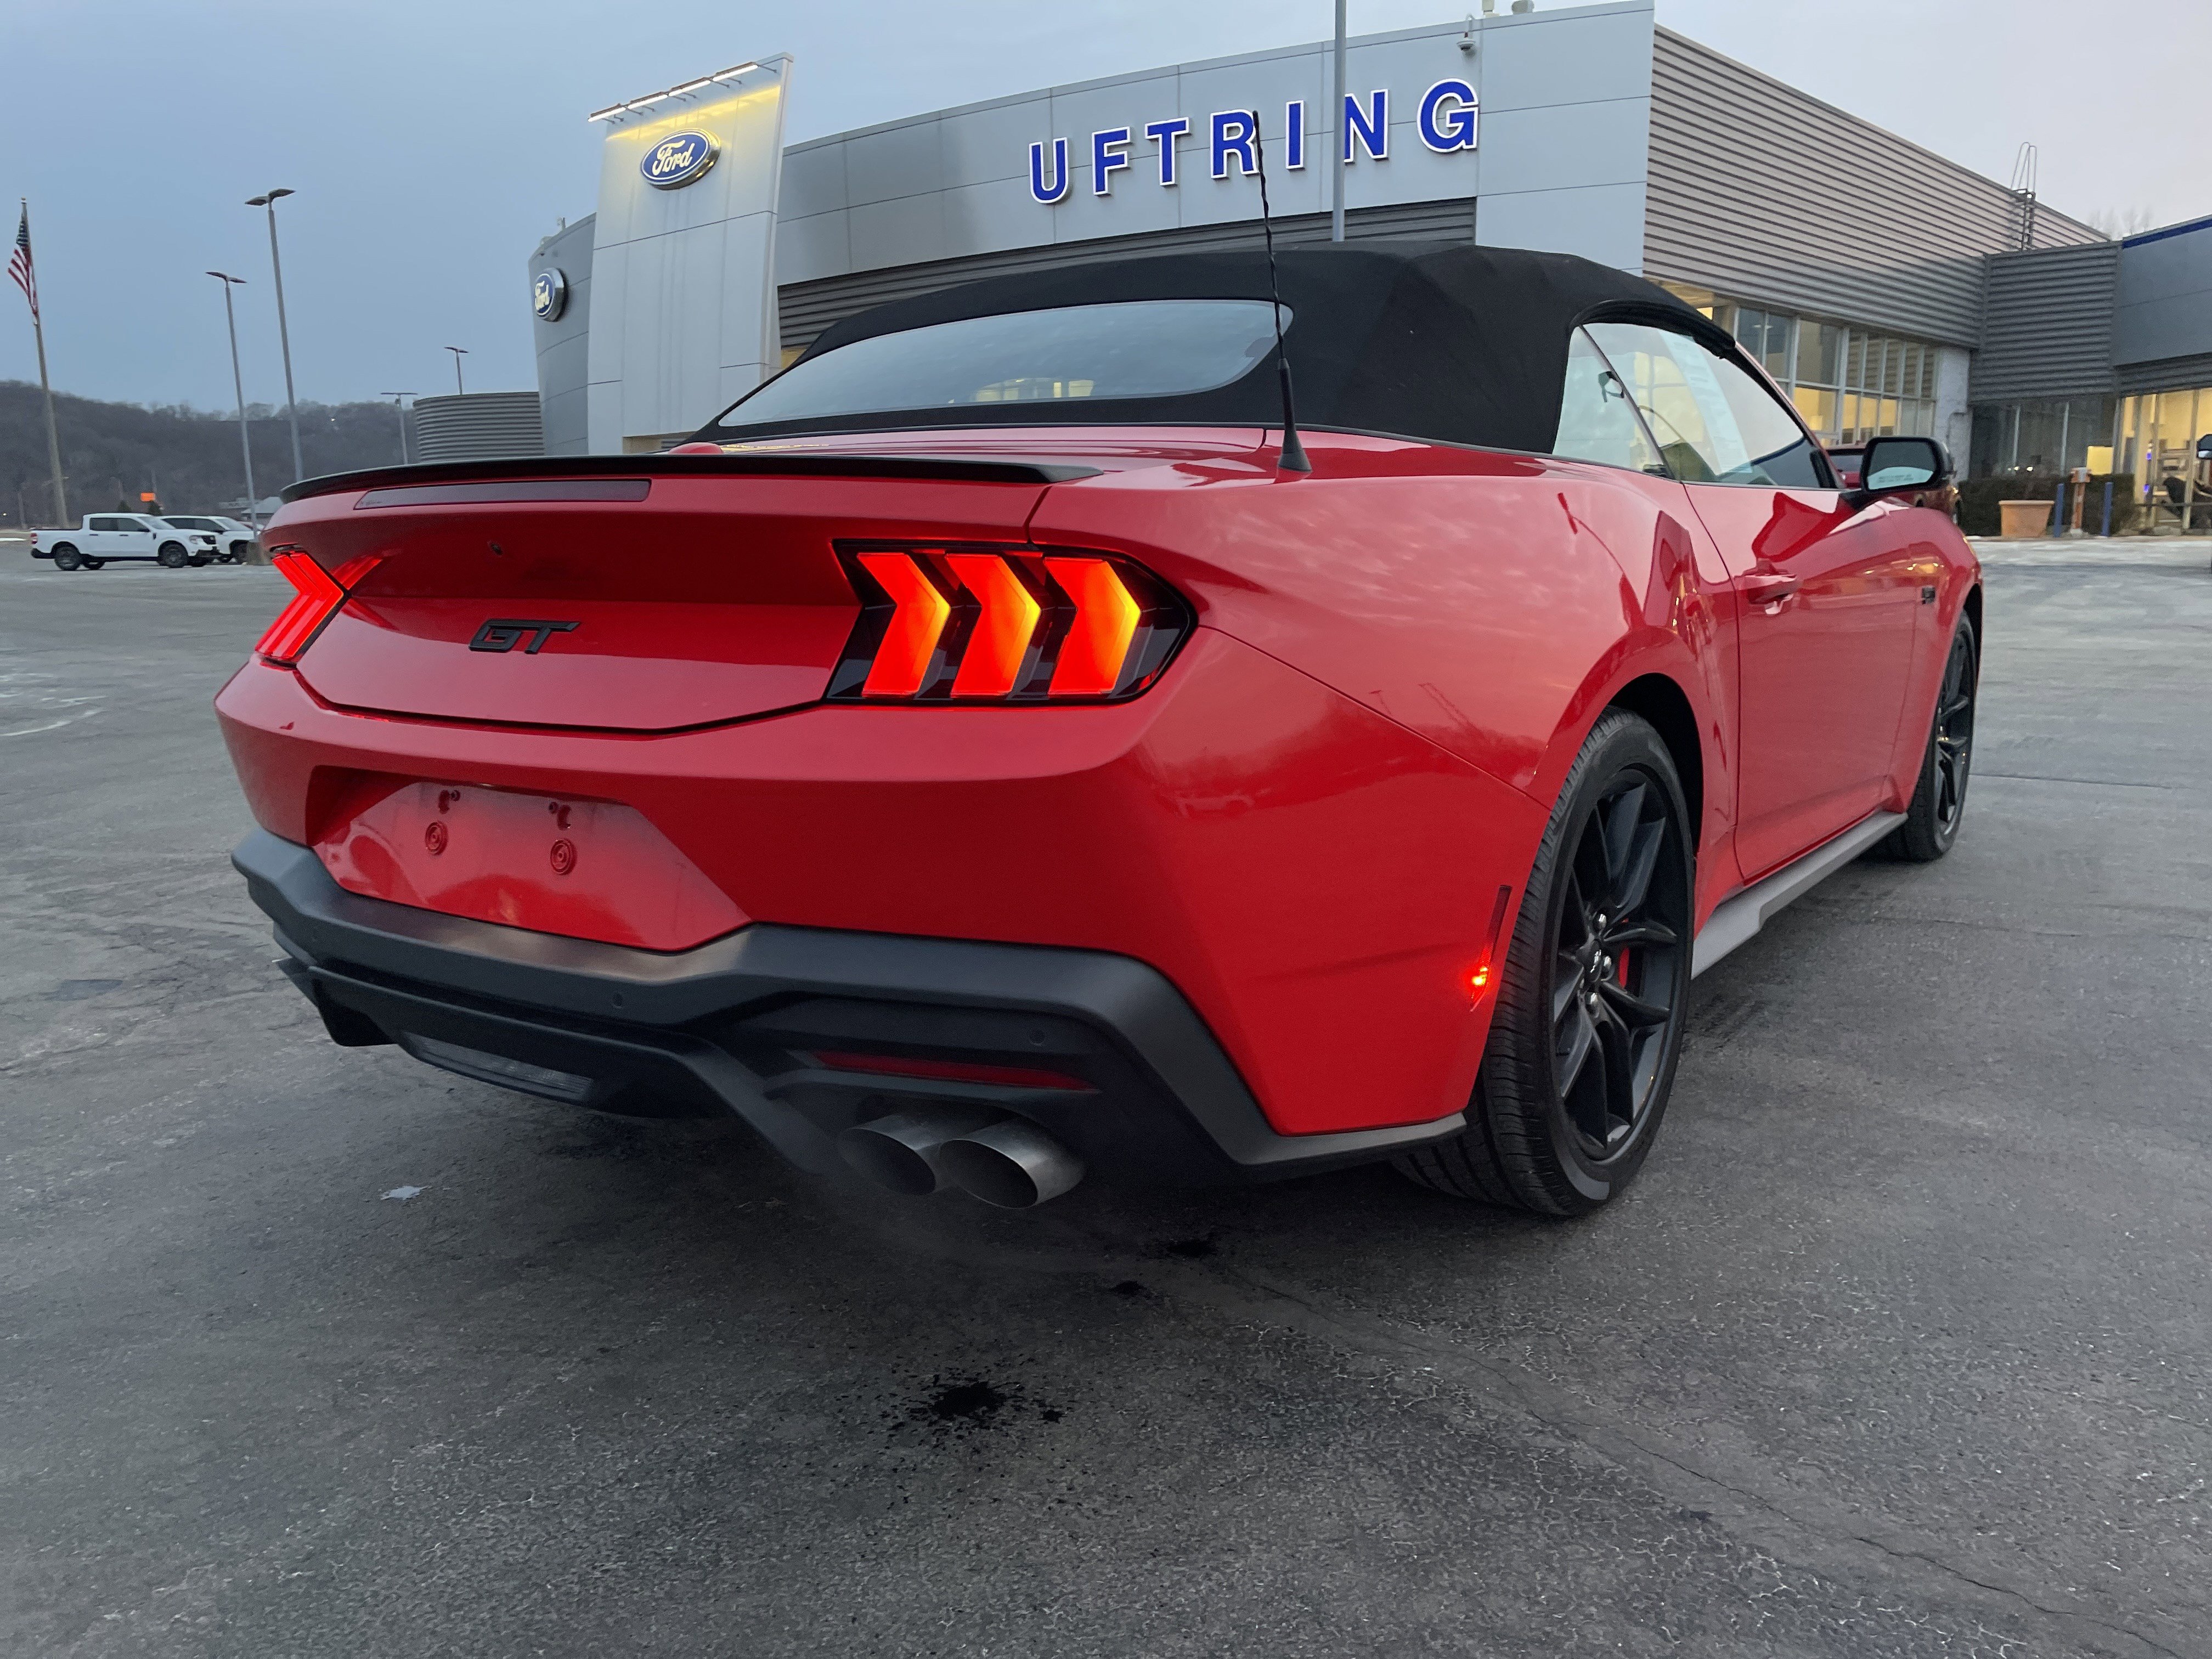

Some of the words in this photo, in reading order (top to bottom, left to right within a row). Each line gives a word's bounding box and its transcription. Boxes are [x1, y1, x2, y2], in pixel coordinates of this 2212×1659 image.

[652, 140, 695, 176] Ford
[1029, 78, 1479, 204] UFTRING
[469, 618, 580, 654] GT
